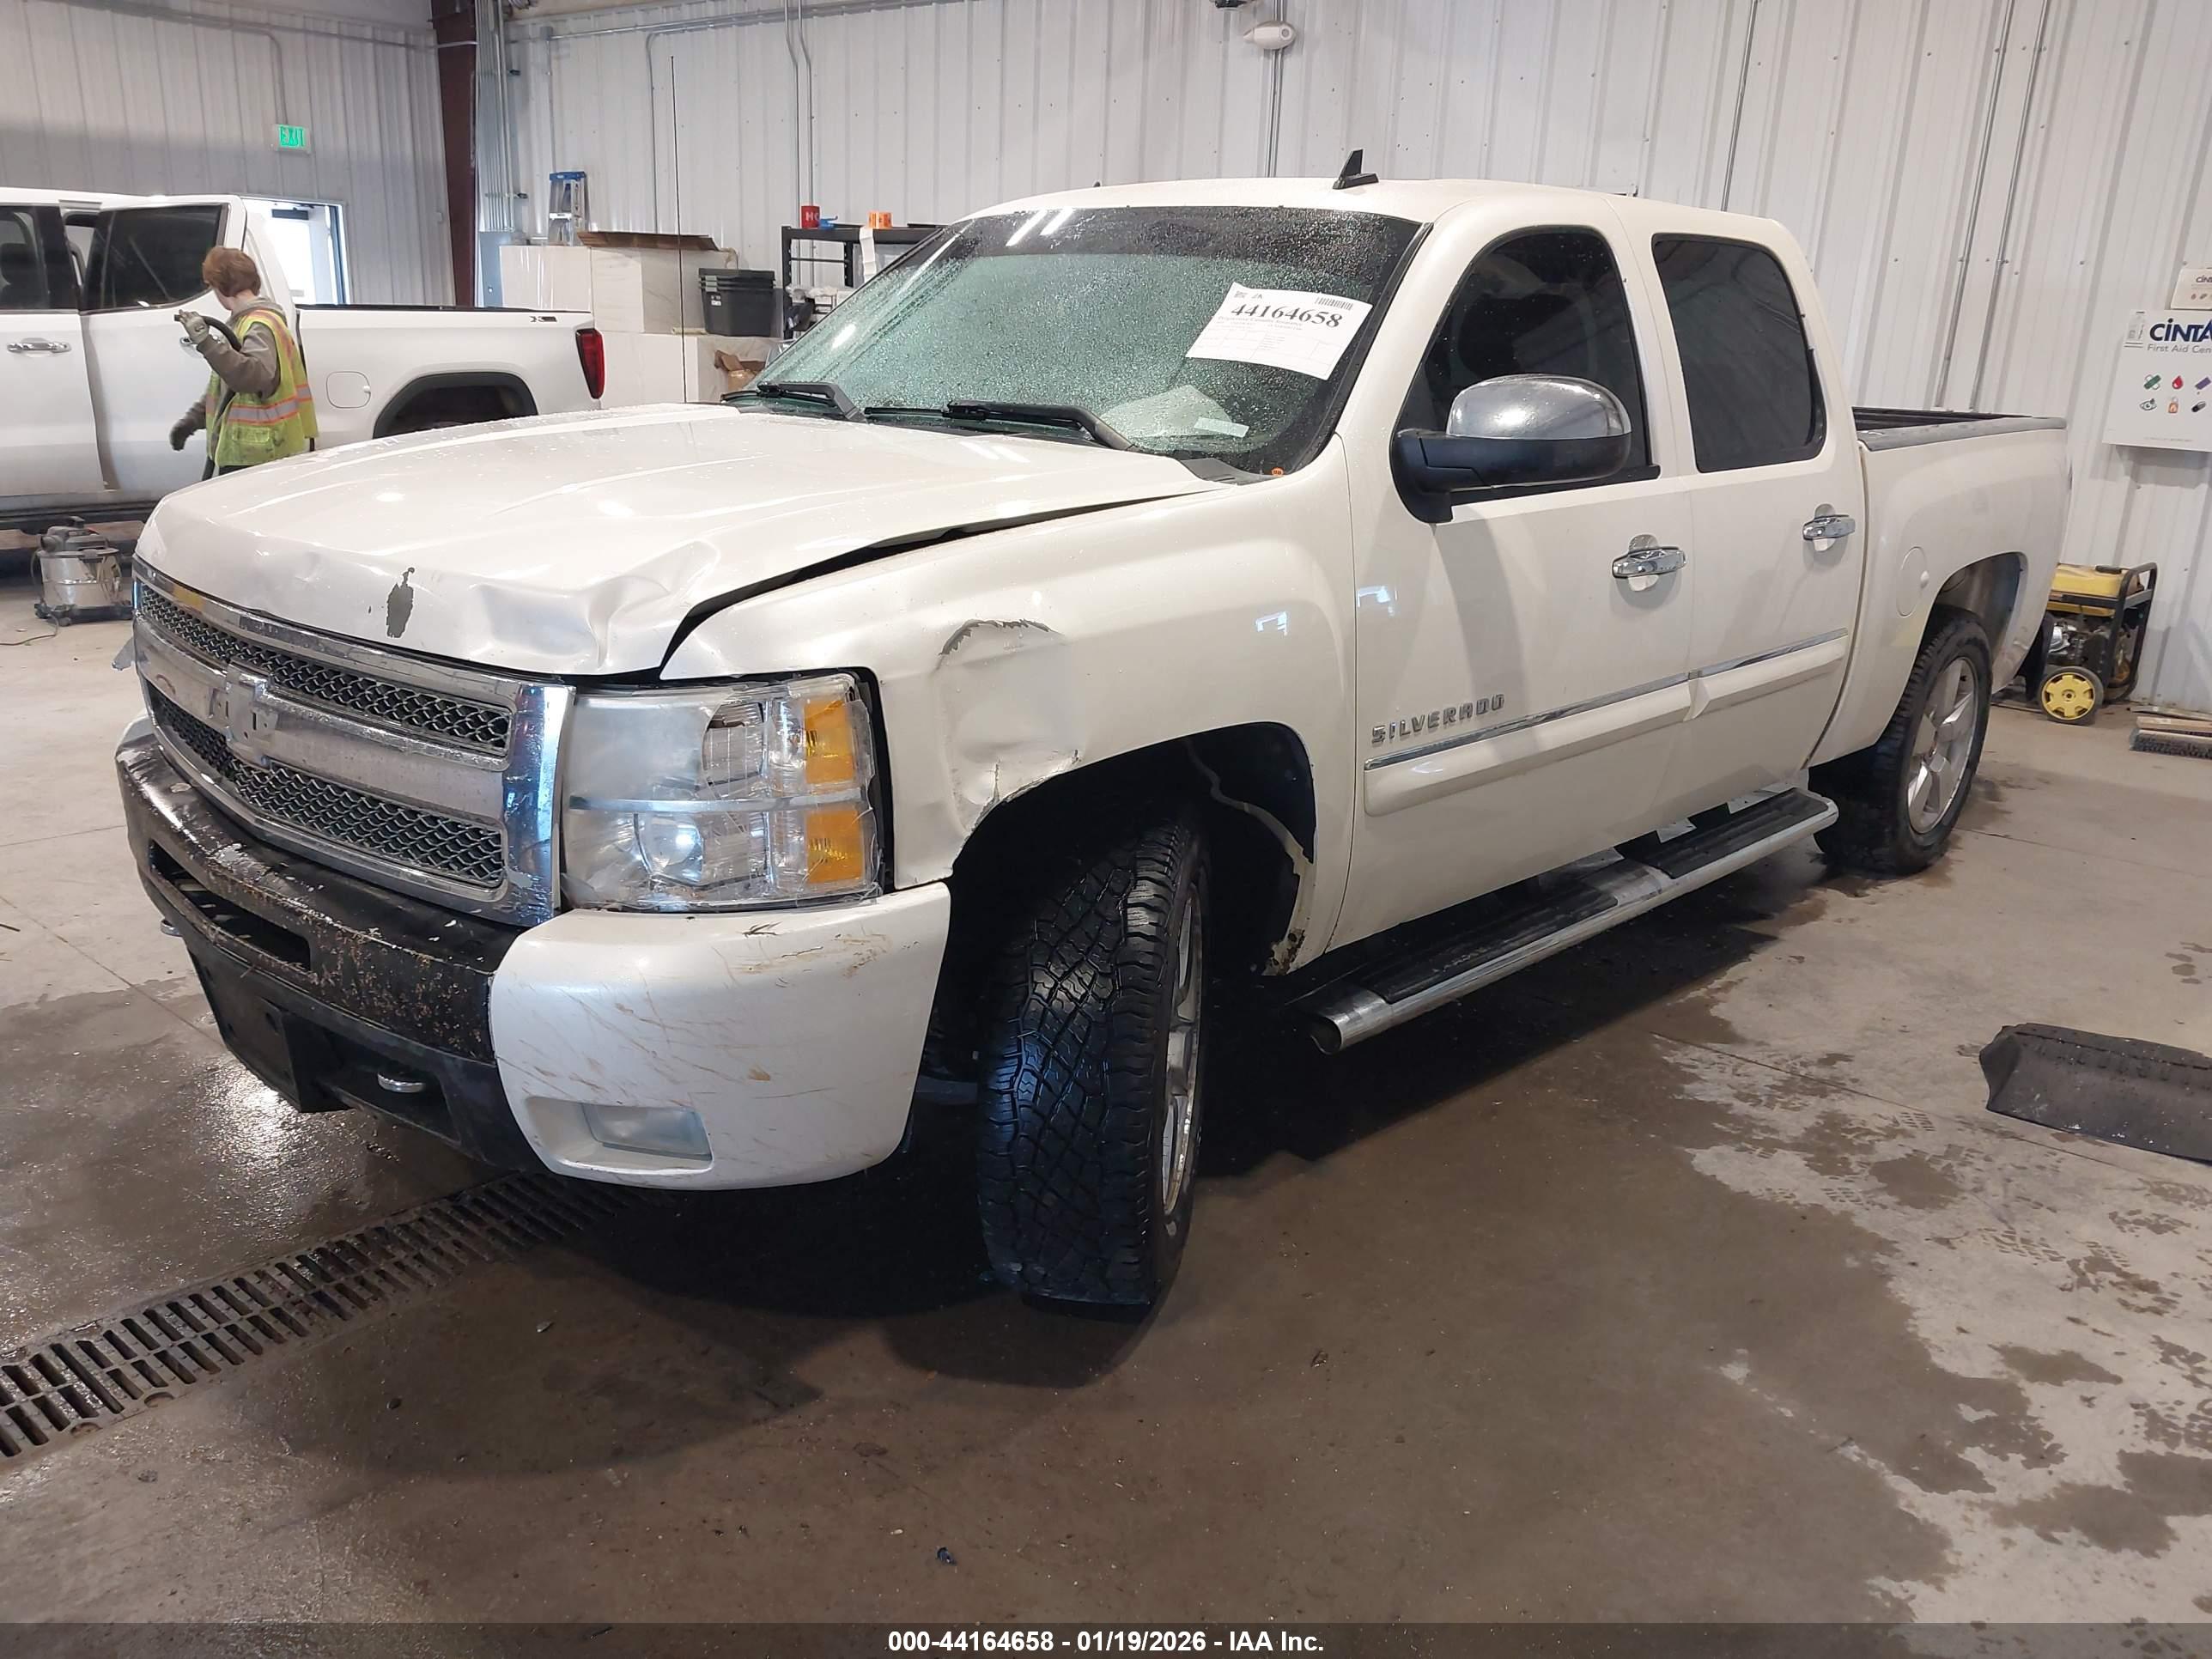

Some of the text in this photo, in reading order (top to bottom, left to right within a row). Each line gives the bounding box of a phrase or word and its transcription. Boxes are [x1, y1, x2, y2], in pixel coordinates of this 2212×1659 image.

[280, 125, 306, 147] EXIT
[1231, 303, 1343, 328] 44164658
[2147, 343, 2168, 352] First
[2171, 344, 2189, 353] Aid
[1371, 694, 1505, 744] SILVERADO
